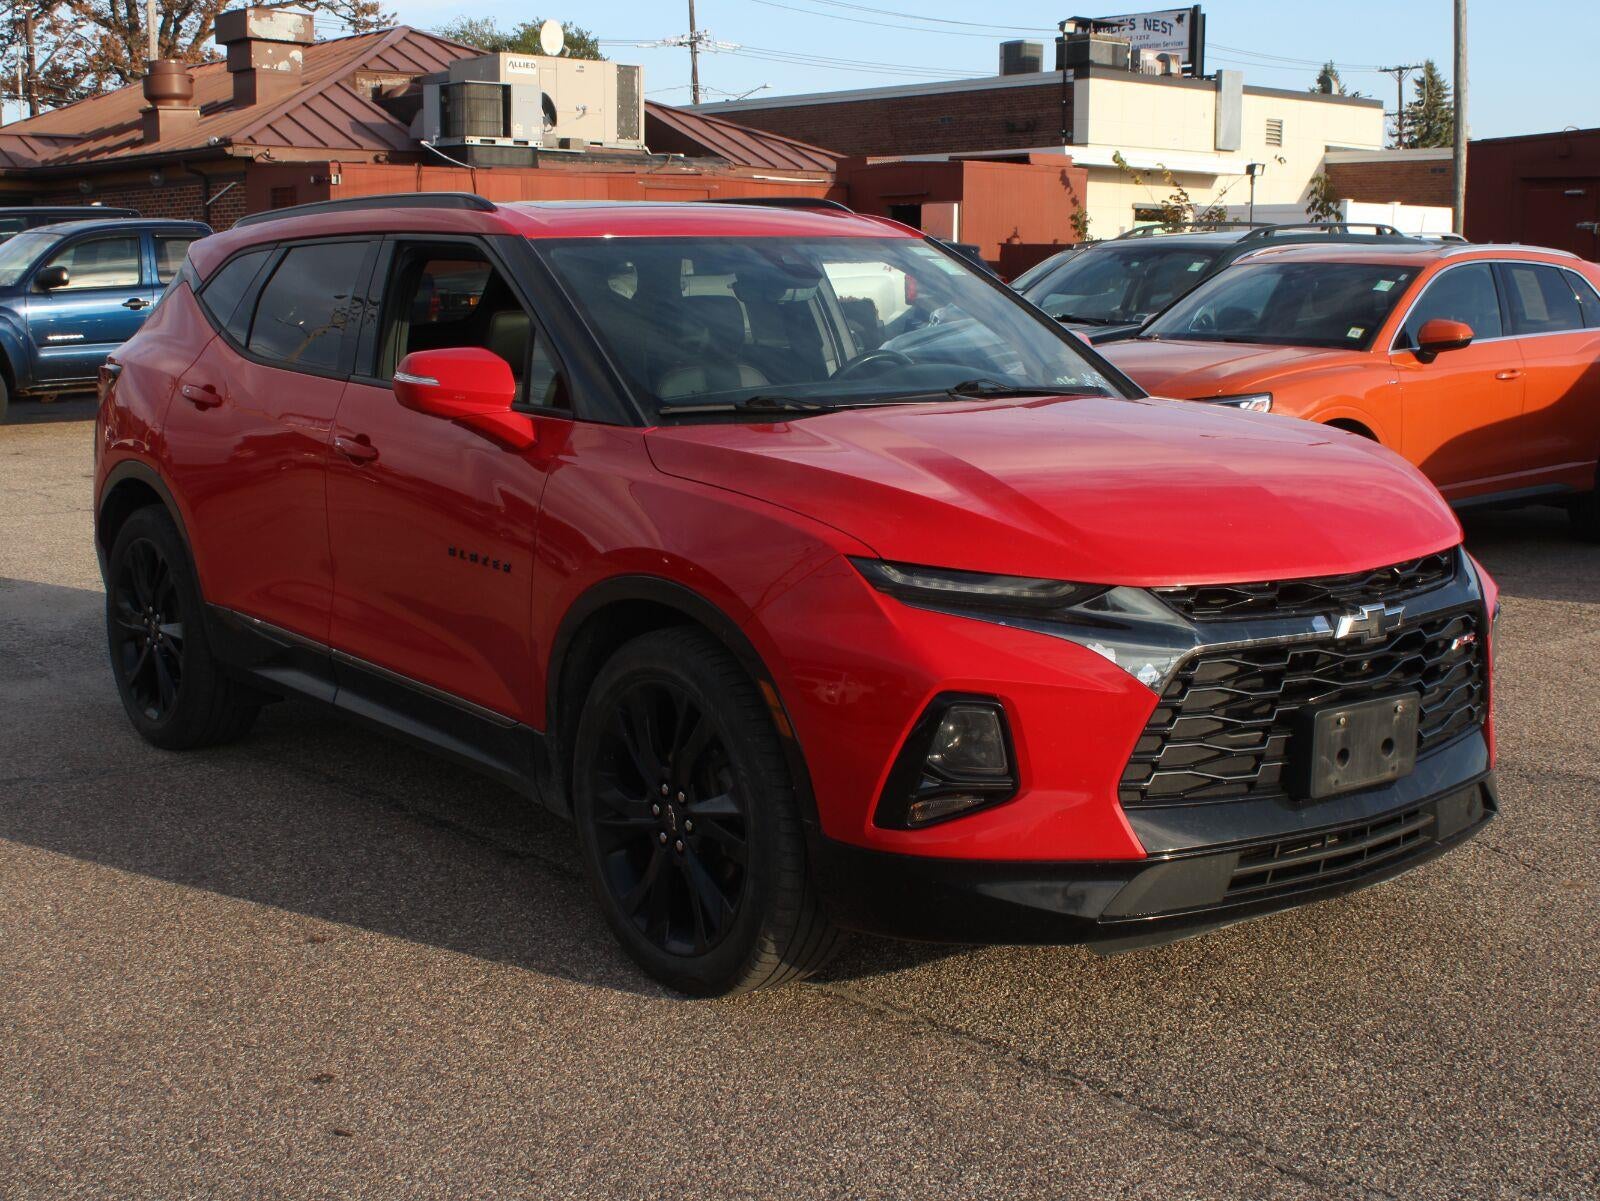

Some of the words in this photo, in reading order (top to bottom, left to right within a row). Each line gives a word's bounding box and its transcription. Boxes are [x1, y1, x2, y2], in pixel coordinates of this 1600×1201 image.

[1143, 17, 1174, 37] NEST
[1163, 40, 1184, 48] Services
[508, 60, 536, 70] ALLIED
